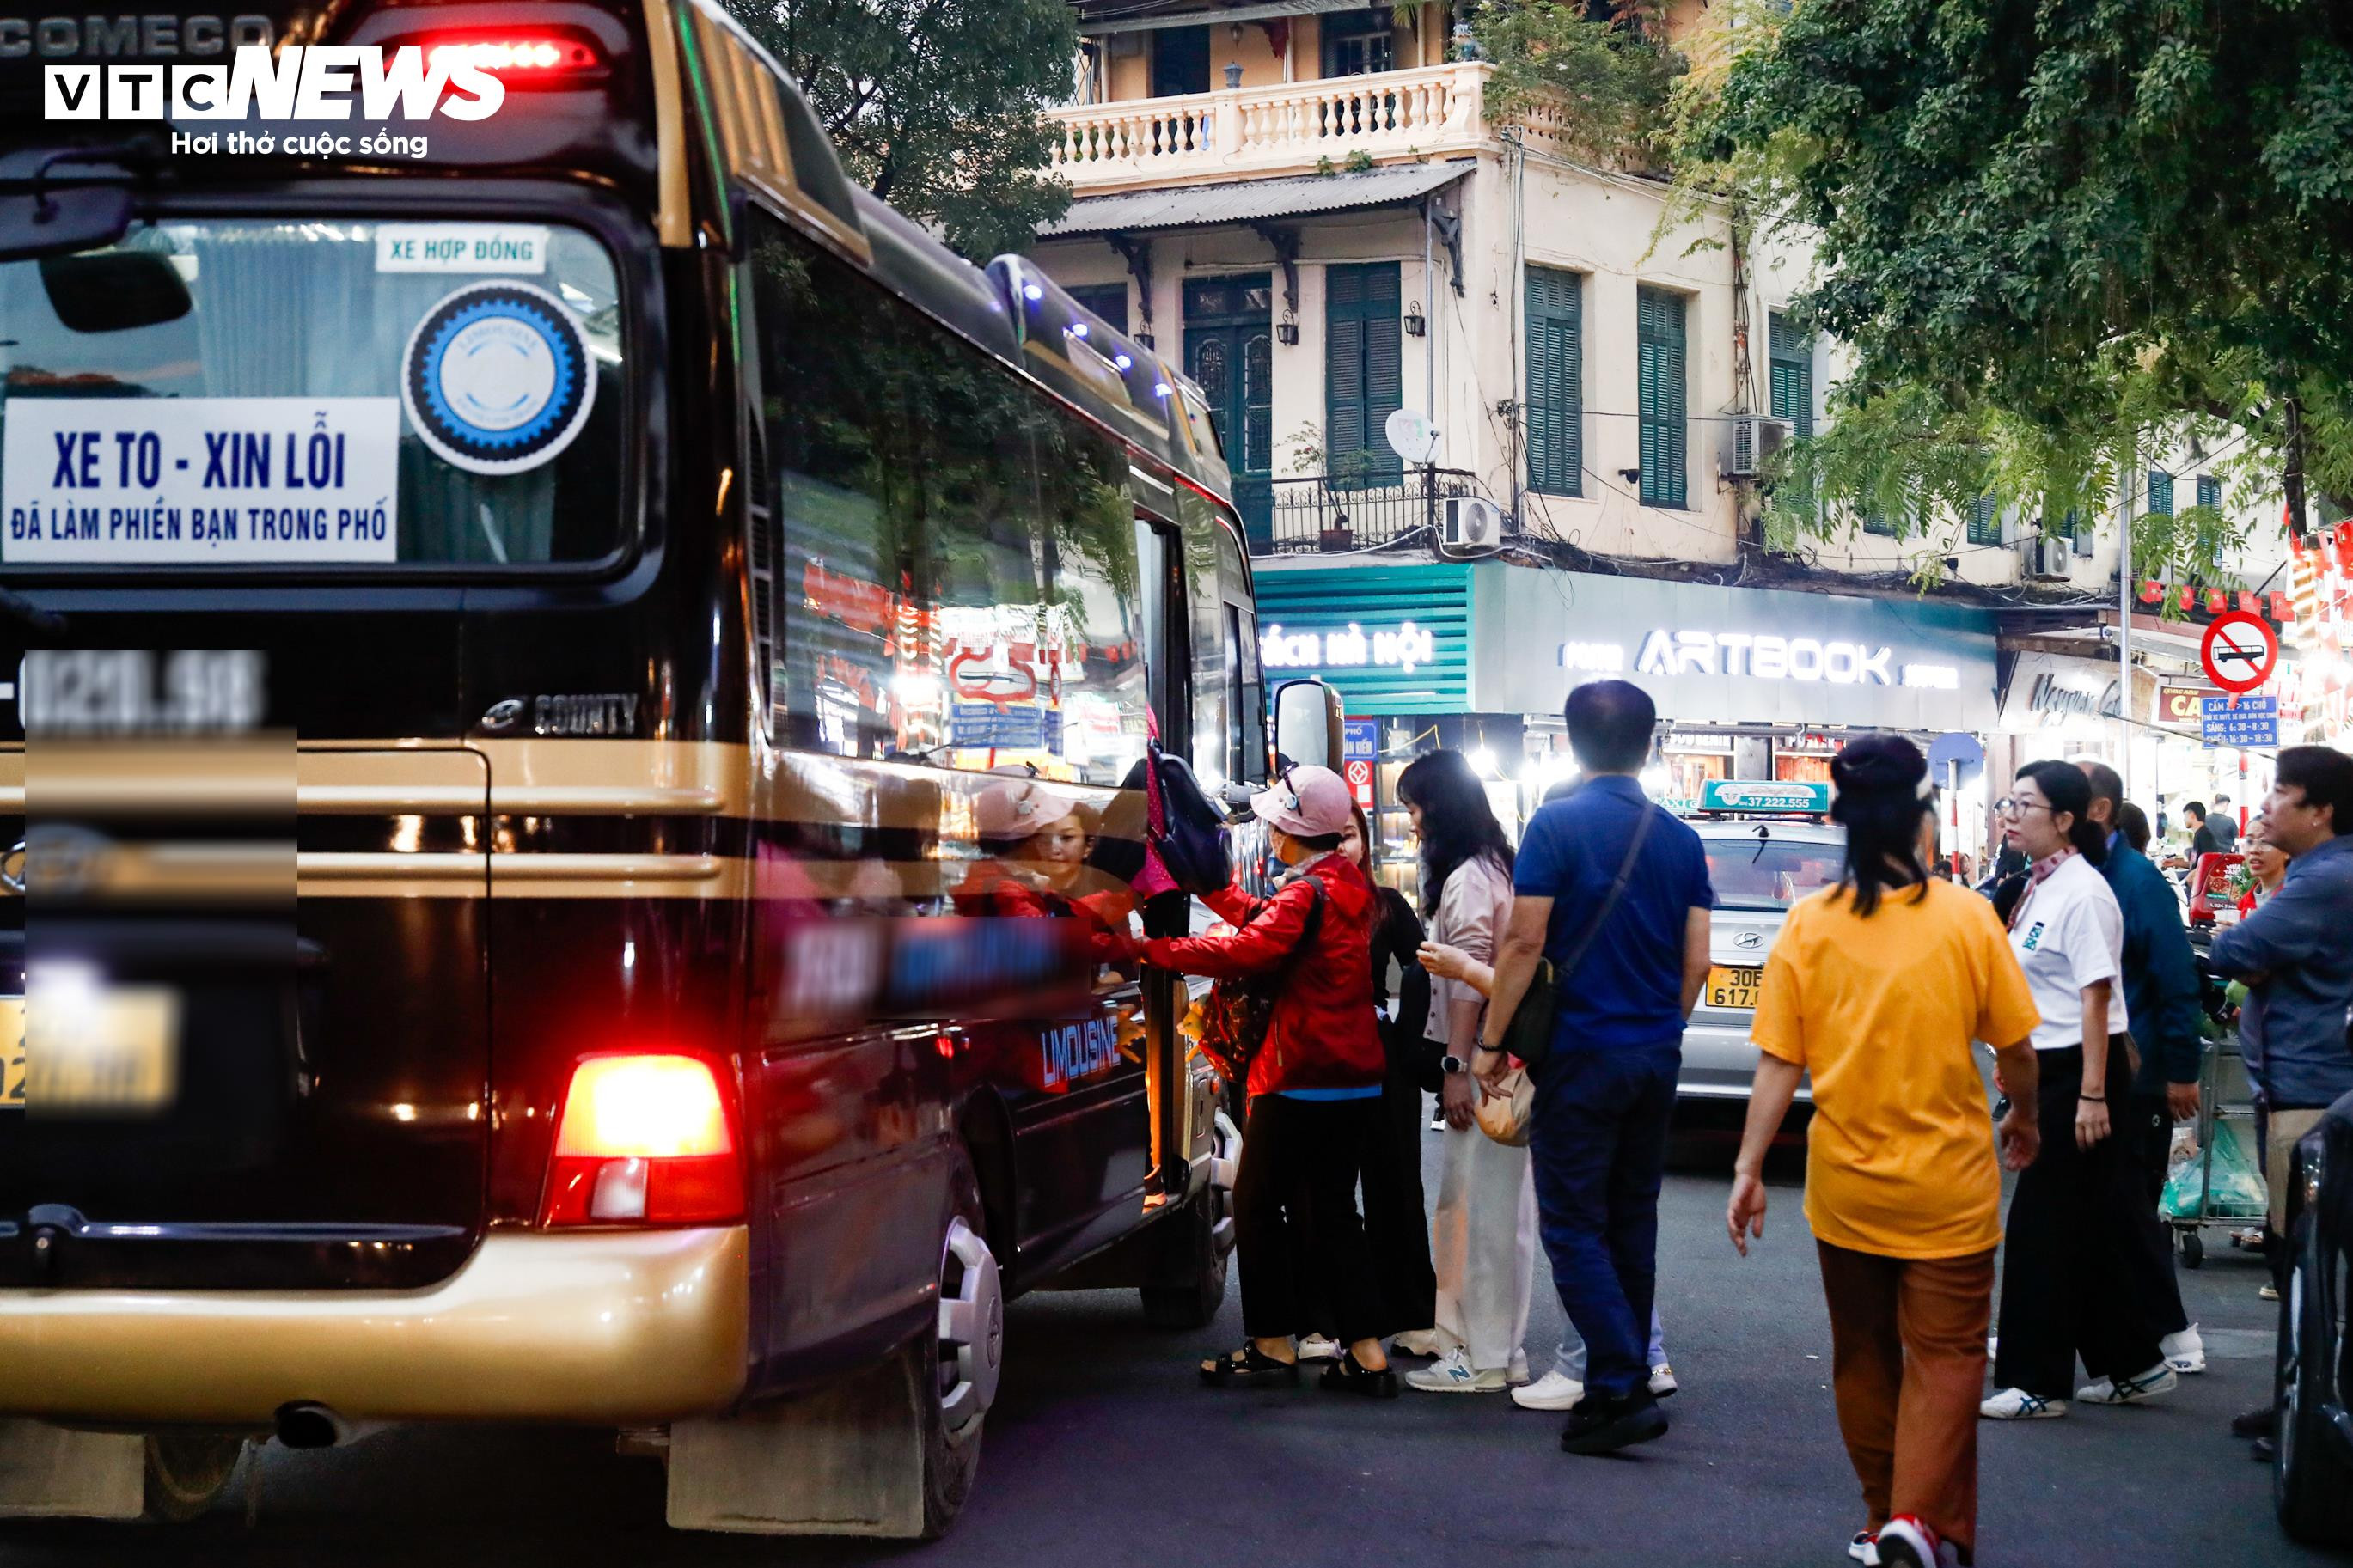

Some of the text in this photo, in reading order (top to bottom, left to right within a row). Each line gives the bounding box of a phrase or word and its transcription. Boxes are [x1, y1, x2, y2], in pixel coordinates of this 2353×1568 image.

[391, 240, 415, 259] XE
[425, 238, 467, 264] HỢP
[52, 430, 101, 490] XE
[115, 430, 162, 490] TO
[202, 431, 271, 489] XIN
[284, 412, 345, 490] LỖI
[10, 501, 42, 540] ĐÃ
[51, 499, 101, 540] LÀM
[191, 508, 238, 548] BẠN
[248, 508, 327, 541] TRONG
[338, 497, 387, 541] PHỐ
[1373, 622, 1432, 674] NỘI
[1636, 629, 1892, 686] ARTBOOK
[1748, 796, 1810, 808] 37.222.555
[1714, 988, 1759, 1006] 617.
[1041, 1015, 1121, 1088] LIMOUSINE
